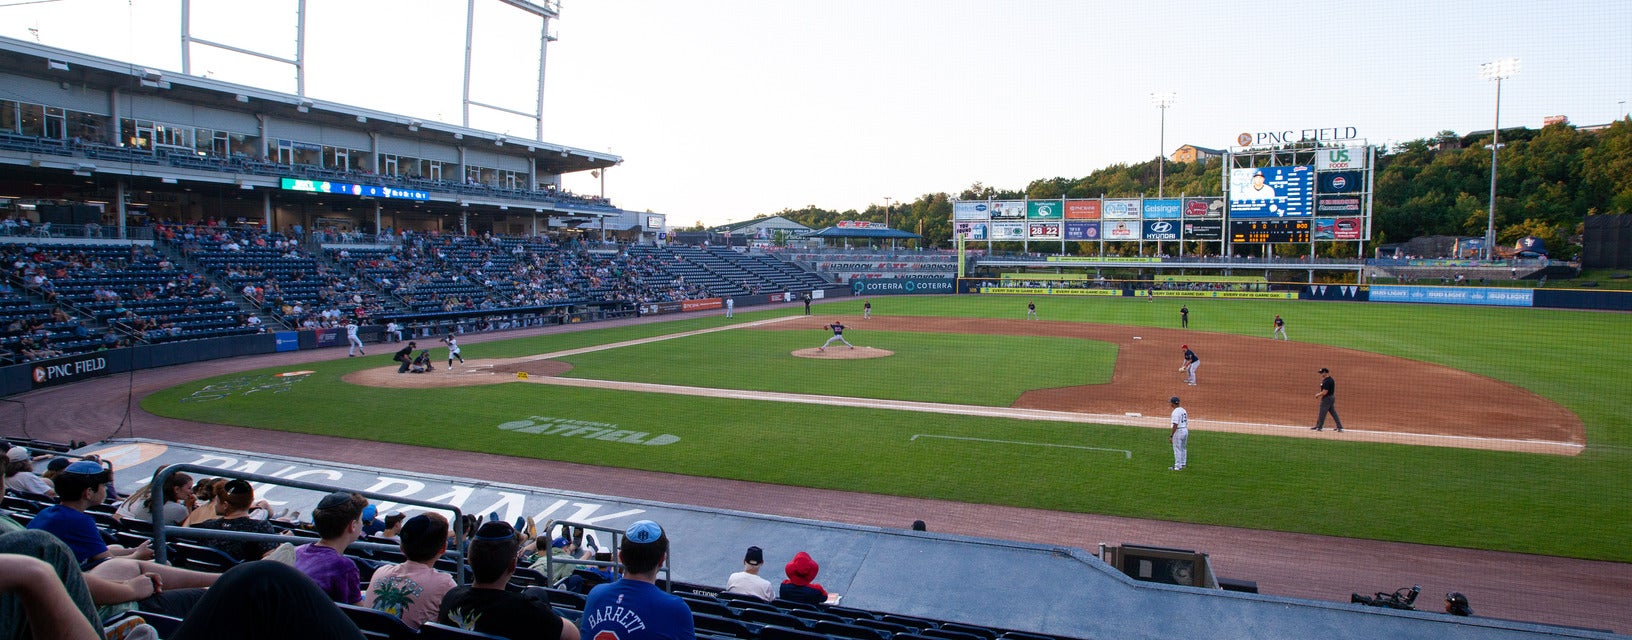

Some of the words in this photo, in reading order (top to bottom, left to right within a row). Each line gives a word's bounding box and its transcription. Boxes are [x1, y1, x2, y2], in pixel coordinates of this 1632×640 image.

[1257, 131, 1293, 144] PNC
[1302, 126, 1357, 141] FIELD
[1144, 205, 1179, 213] Geisinger
[1031, 227, 1043, 235] 28
[1046, 227, 1058, 235] 22
[47, 363, 72, 379] PNC
[75, 357, 106, 374] FIELD
[588, 605, 646, 634] BARRETT
